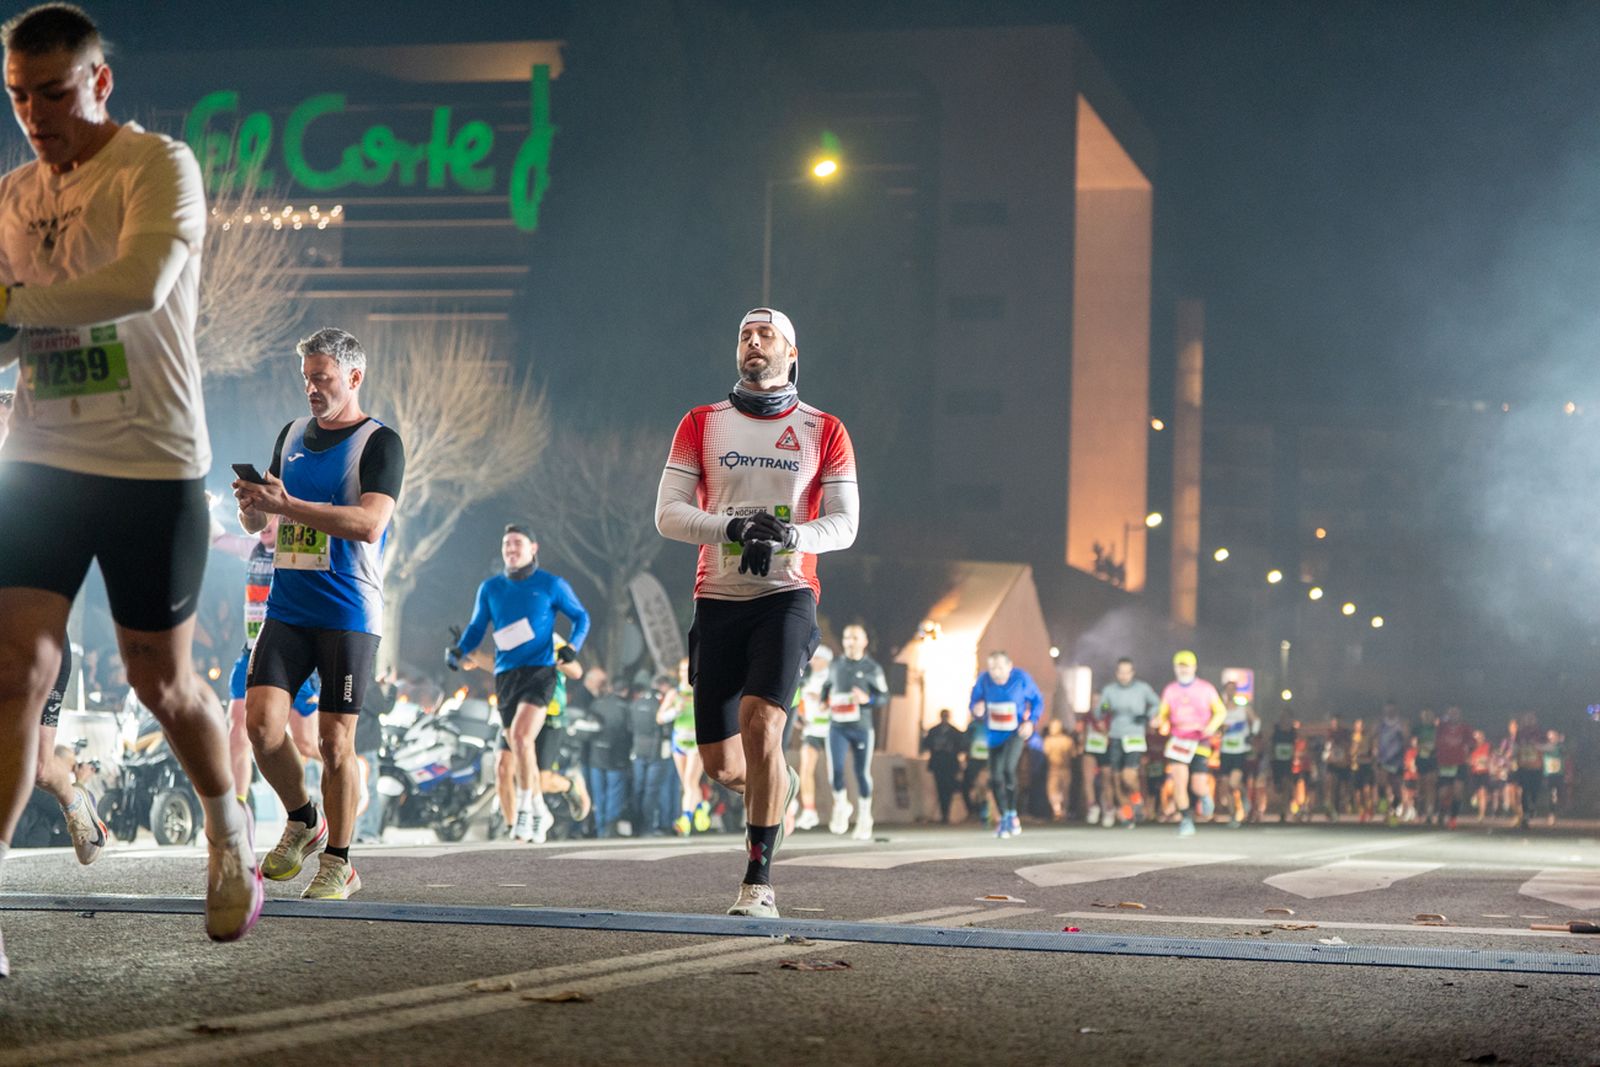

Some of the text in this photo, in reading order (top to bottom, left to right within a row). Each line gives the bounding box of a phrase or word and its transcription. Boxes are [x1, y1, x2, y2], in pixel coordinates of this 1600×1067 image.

[284, 93, 494, 191] Corte
[719, 451, 800, 472] TORYTRANS
[735, 508, 757, 517] NOCHE
